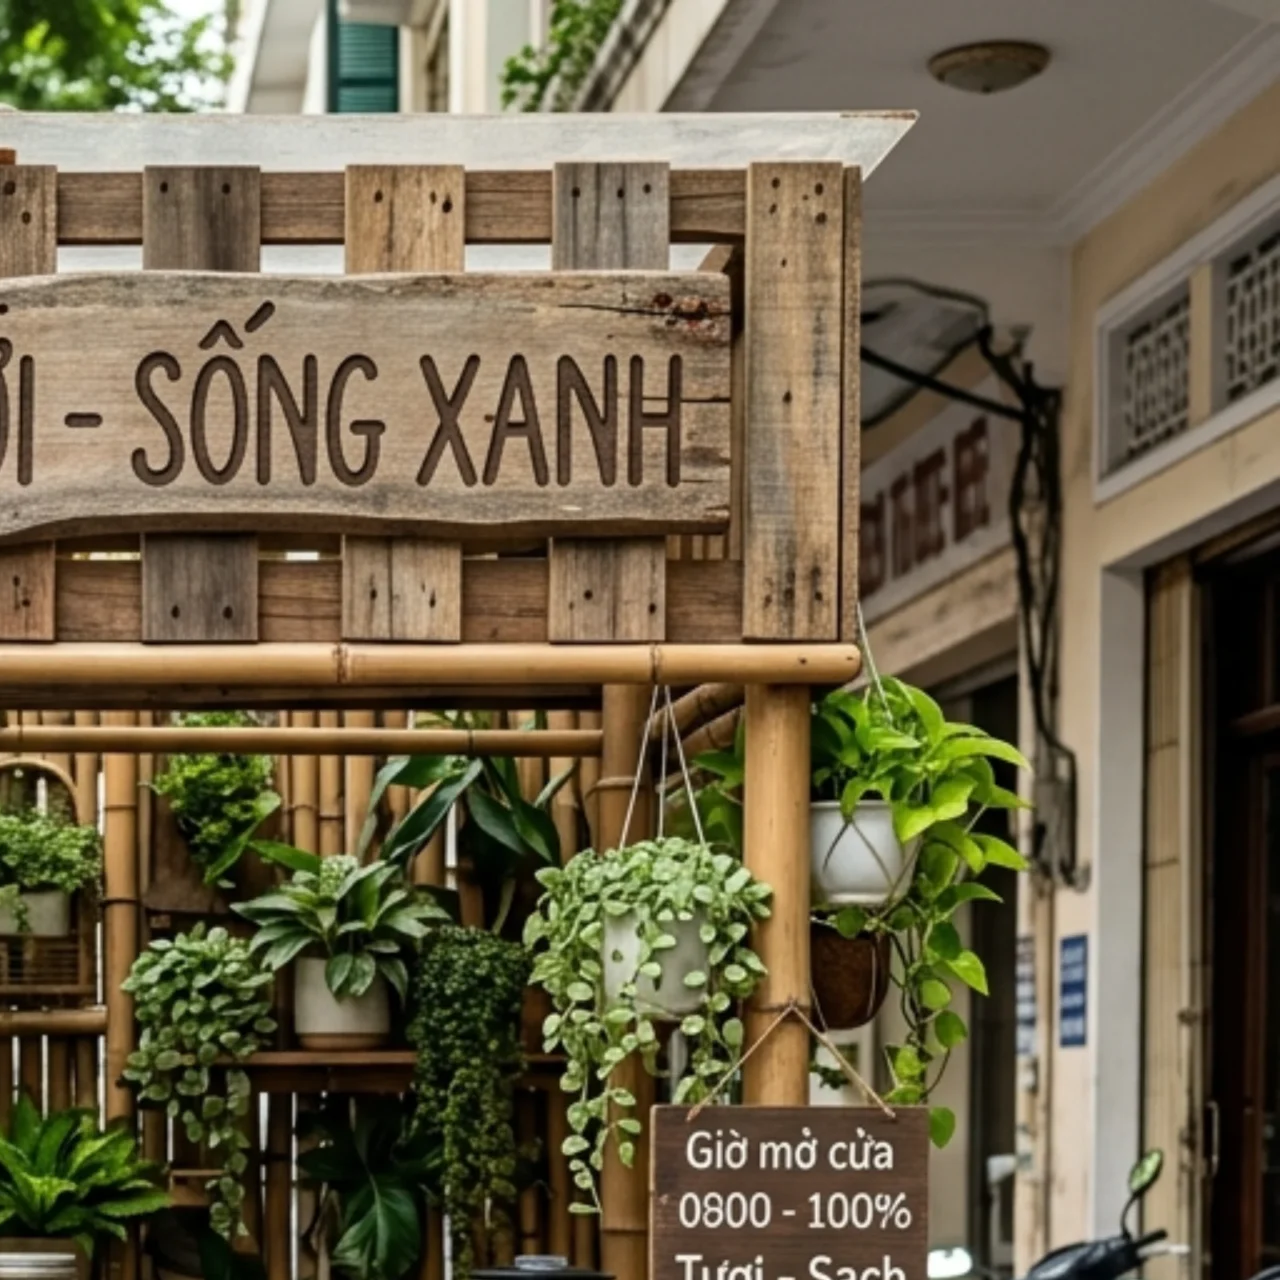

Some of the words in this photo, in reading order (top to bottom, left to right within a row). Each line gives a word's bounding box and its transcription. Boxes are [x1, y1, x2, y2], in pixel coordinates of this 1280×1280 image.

[64, 411, 103, 428] -
[130, 300, 387, 487] SỐNG
[415, 353, 683, 487] XANH
[685, 1128, 749, 1170] Giờ
[678, 1191, 771, 1229] 0800
[807, 1191, 913, 1229] 100%
